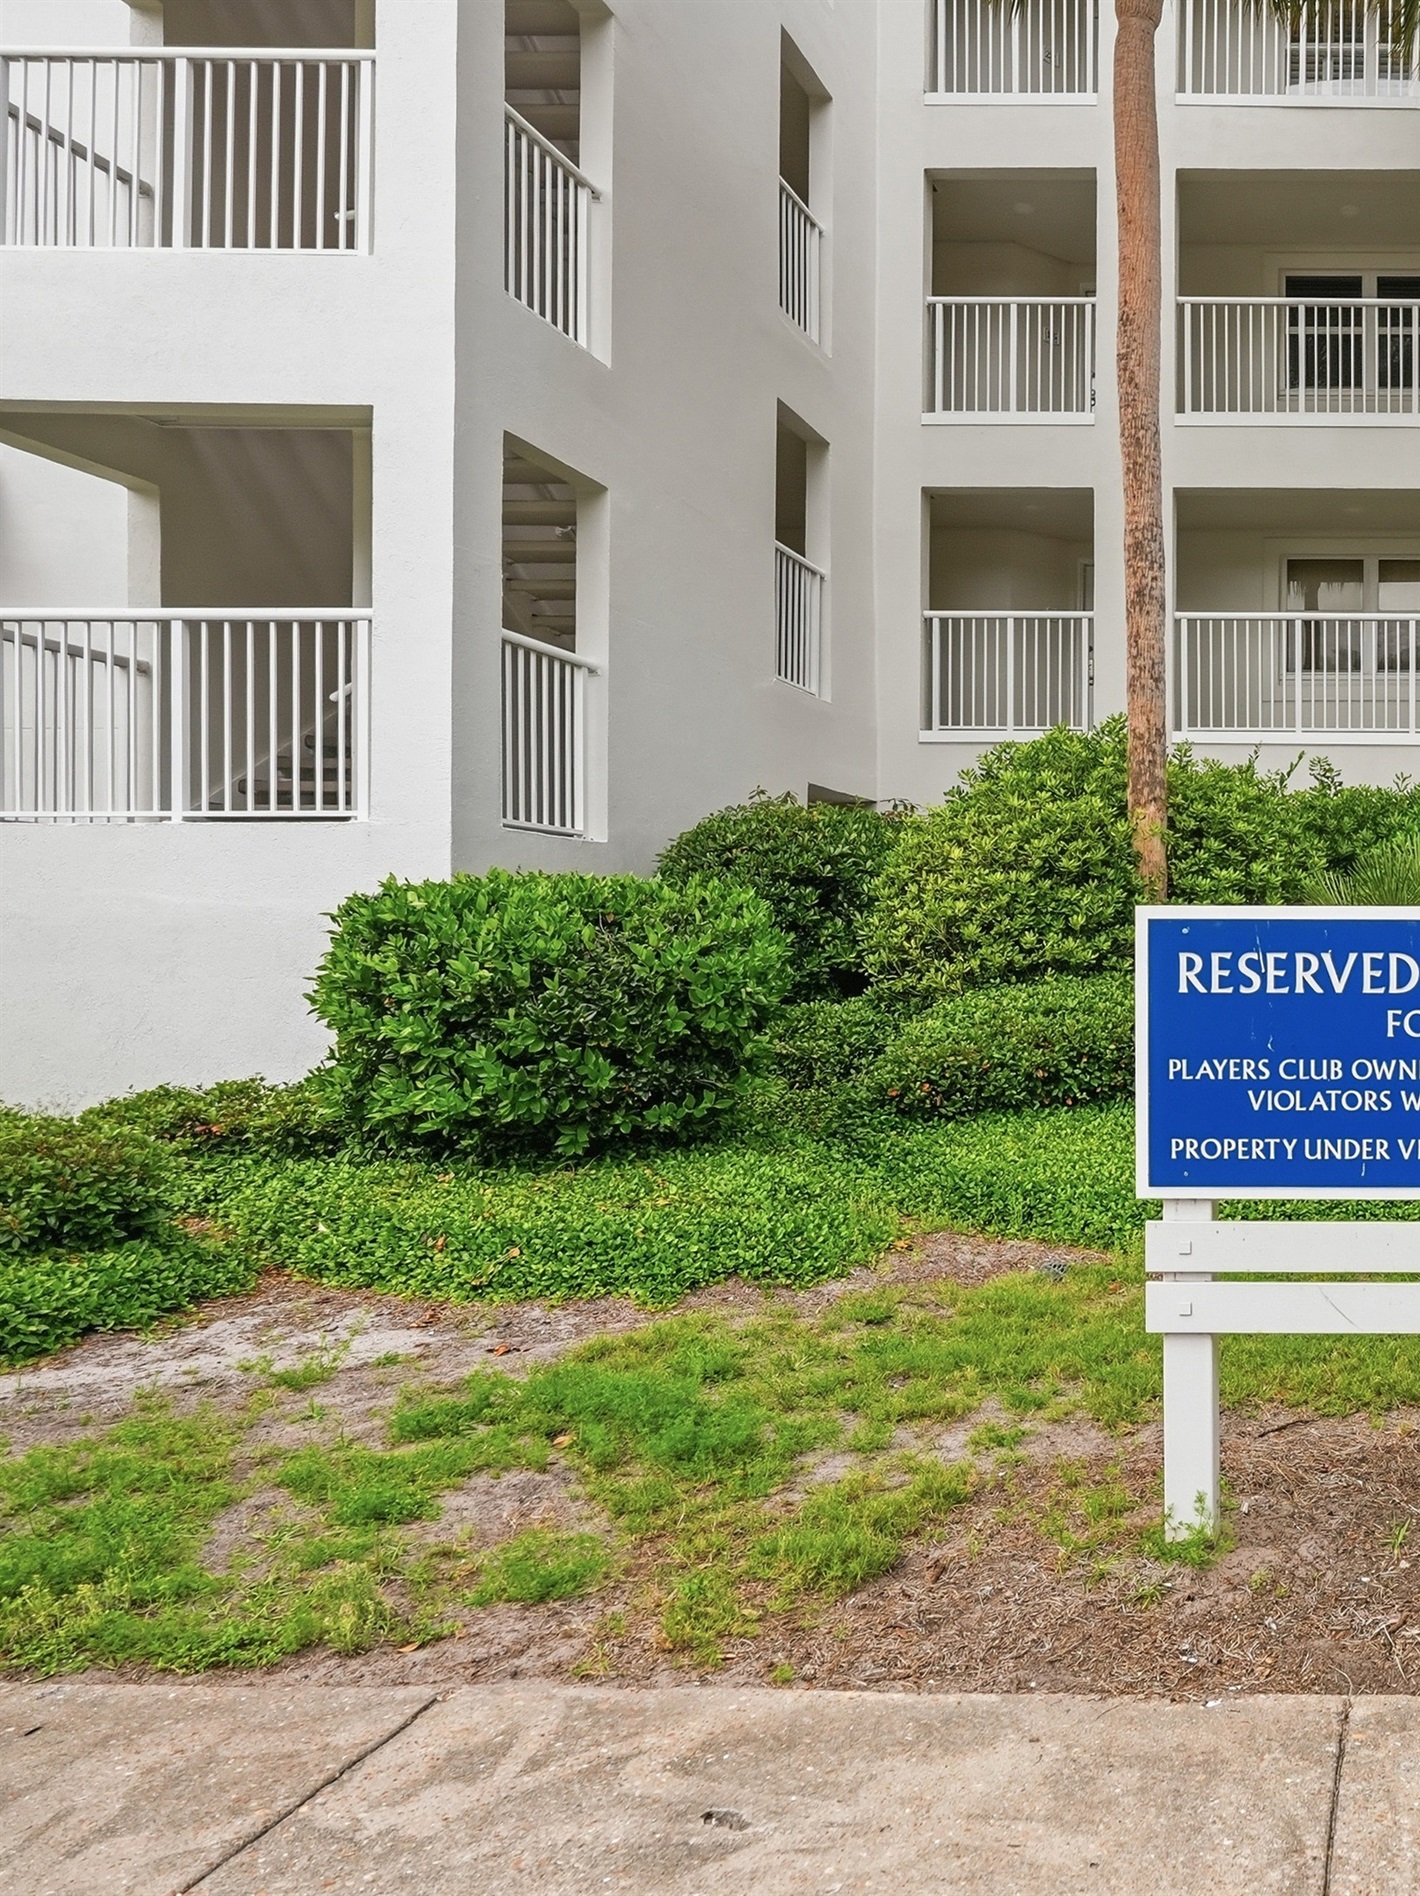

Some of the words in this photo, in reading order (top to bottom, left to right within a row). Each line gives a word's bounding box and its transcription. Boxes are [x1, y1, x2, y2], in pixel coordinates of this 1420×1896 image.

[1178, 951, 1420, 994] RESERVED
[1168, 1058, 1271, 1080] PLAYERS
[1278, 1058, 1343, 1081] CLUB
[1247, 1089, 1392, 1112] VIOLATORS
[1170, 1138, 1298, 1160] PROPERTY
[1304, 1138, 1391, 1160] UNDER
